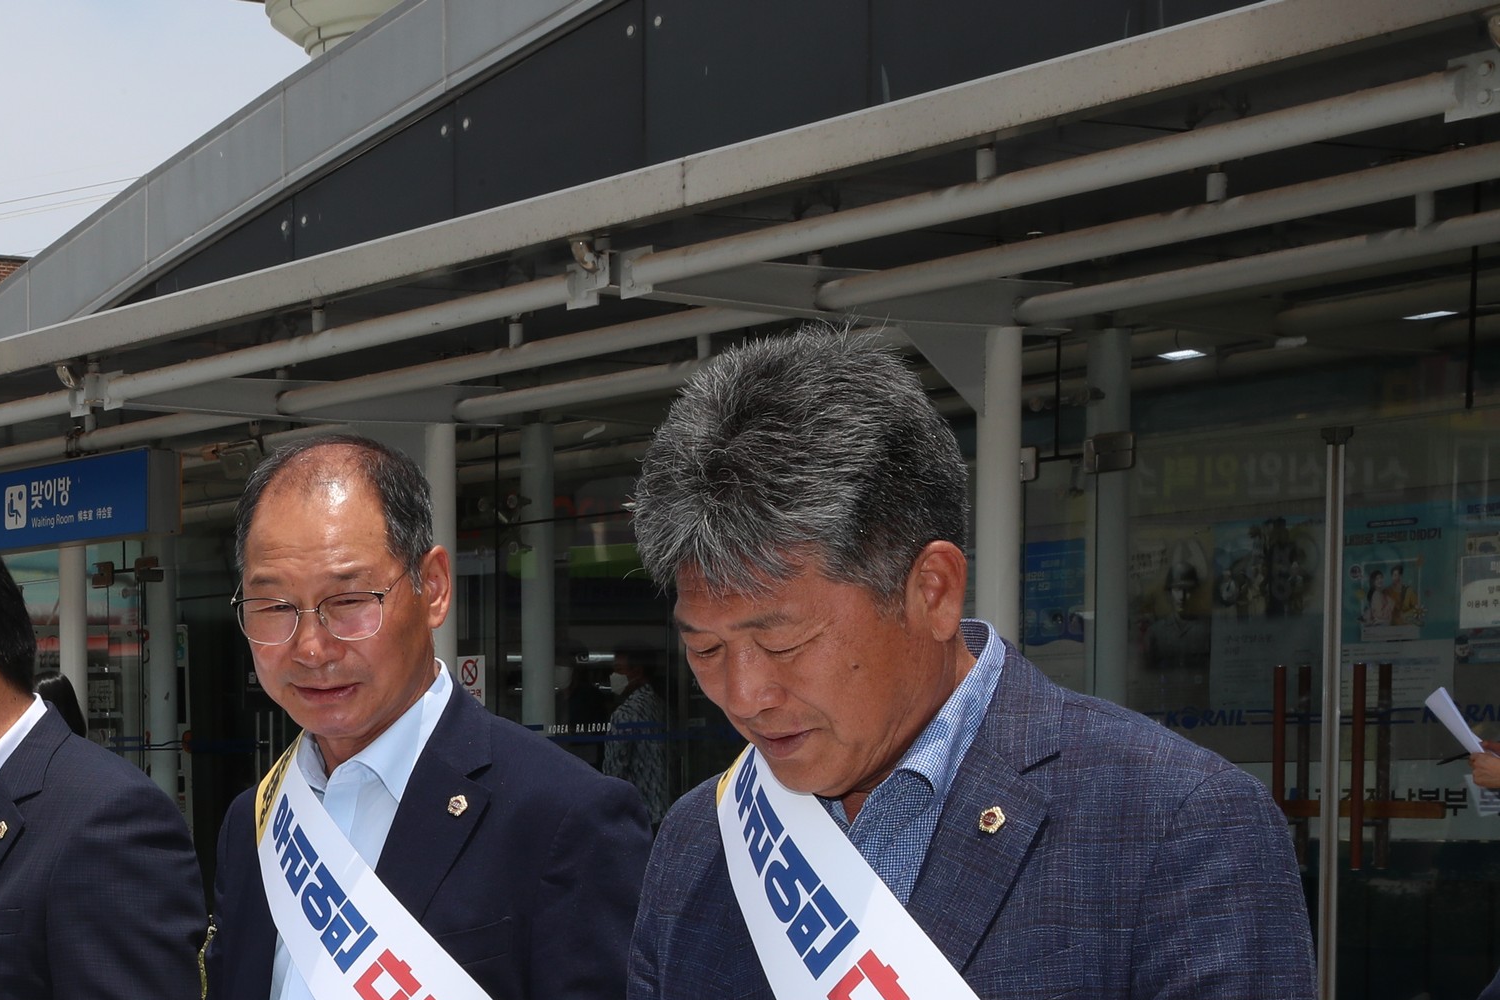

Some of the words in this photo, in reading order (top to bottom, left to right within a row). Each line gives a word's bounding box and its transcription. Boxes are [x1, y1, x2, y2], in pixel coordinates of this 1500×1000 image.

[31, 476, 72, 510] 맞이방
[31, 515, 55, 530] Waiting
[56, 513, 75, 526] Room
[1409, 527, 1442, 542] 이야기
[734, 744, 859, 980] 우리어민
[272, 794, 378, 974] 우리어민
